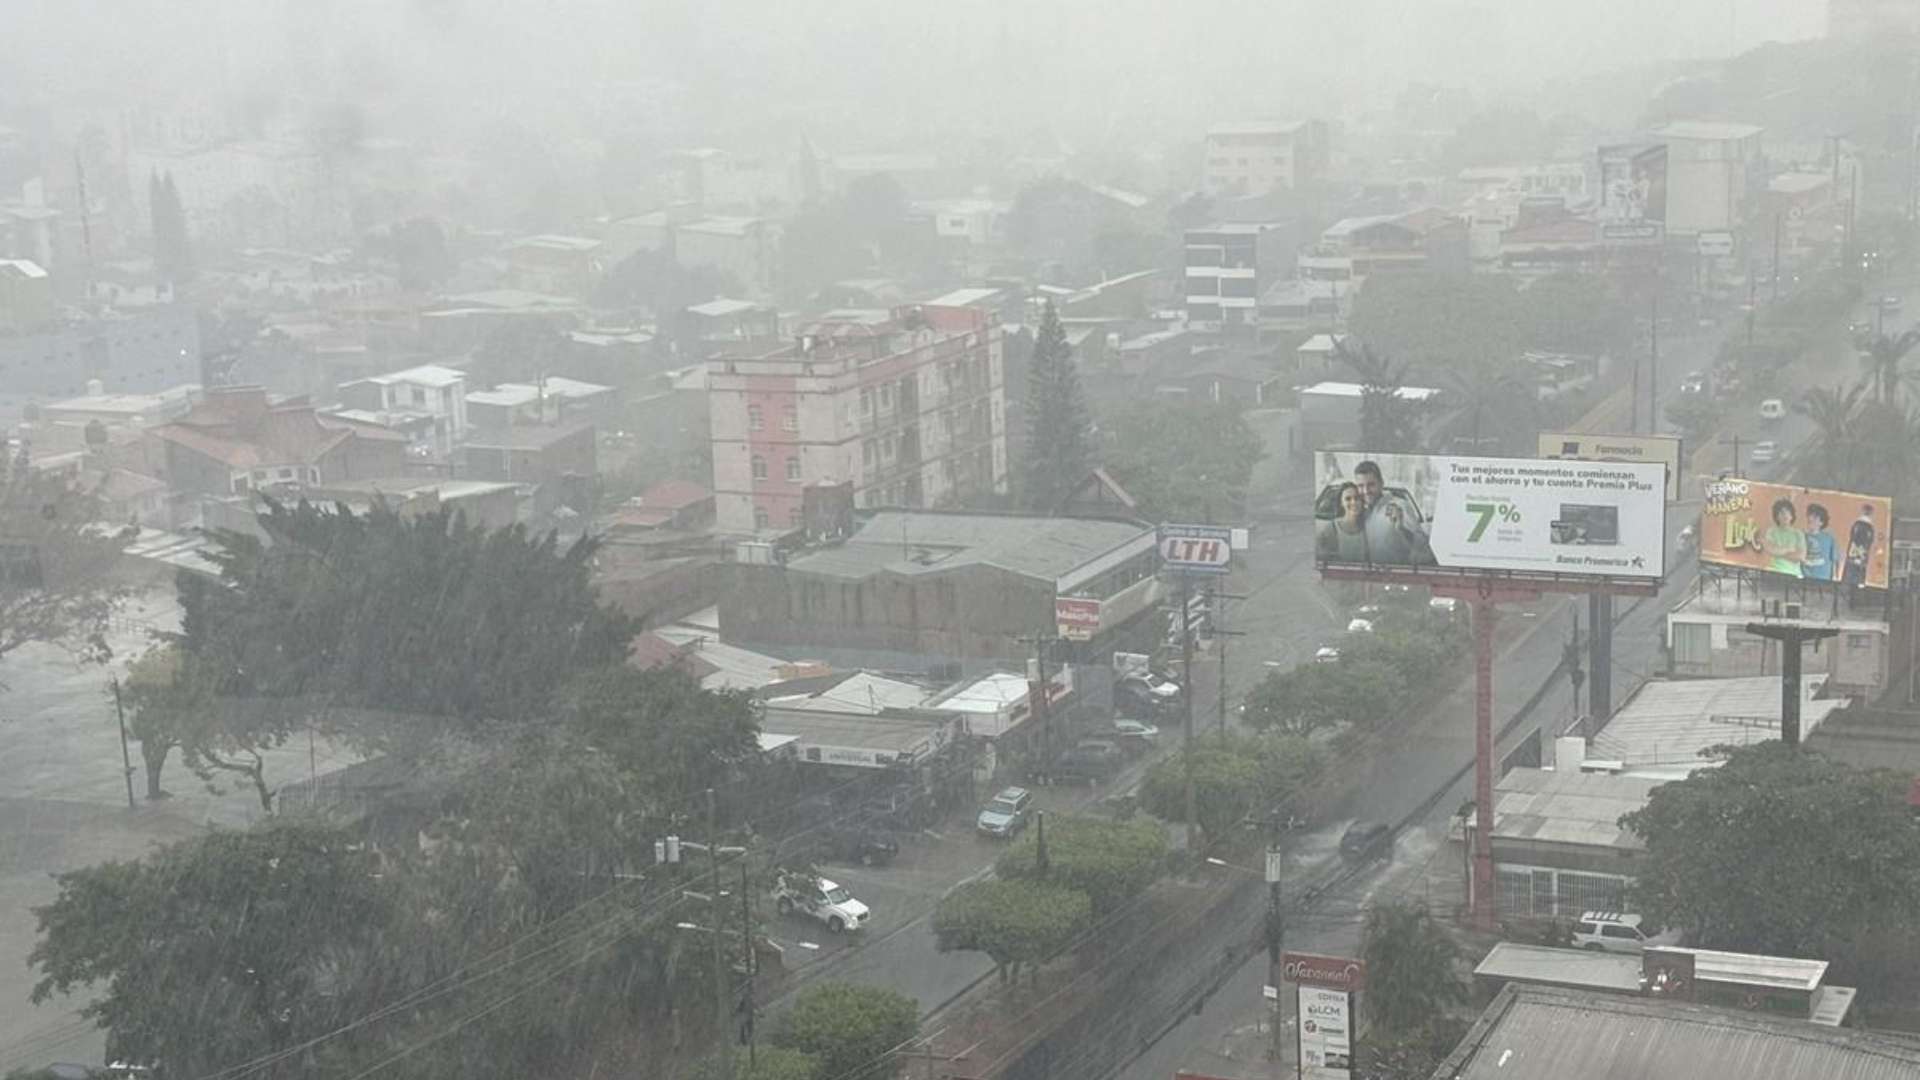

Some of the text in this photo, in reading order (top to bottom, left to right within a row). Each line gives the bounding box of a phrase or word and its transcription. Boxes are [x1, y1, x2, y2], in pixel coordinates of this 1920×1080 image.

[1595, 444, 1643, 455] Farmacia
[1451, 464, 1635, 480] Tus mejores momentos comienzan
[1450, 475, 1469, 483] con
[1472, 475, 1482, 484] el
[1484, 476, 1521, 485] ahorro
[1533, 477, 1545, 486] tu
[1547, 479, 1584, 488] cuenta
[1628, 481, 1653, 491] Plus
[1704, 481, 1749, 497] VERANO
[1466, 503, 1521, 543] 7%
[1168, 539, 1219, 562] LTH
[1556, 554, 1583, 564] Banco
[1584, 556, 1629, 567] Promerica
